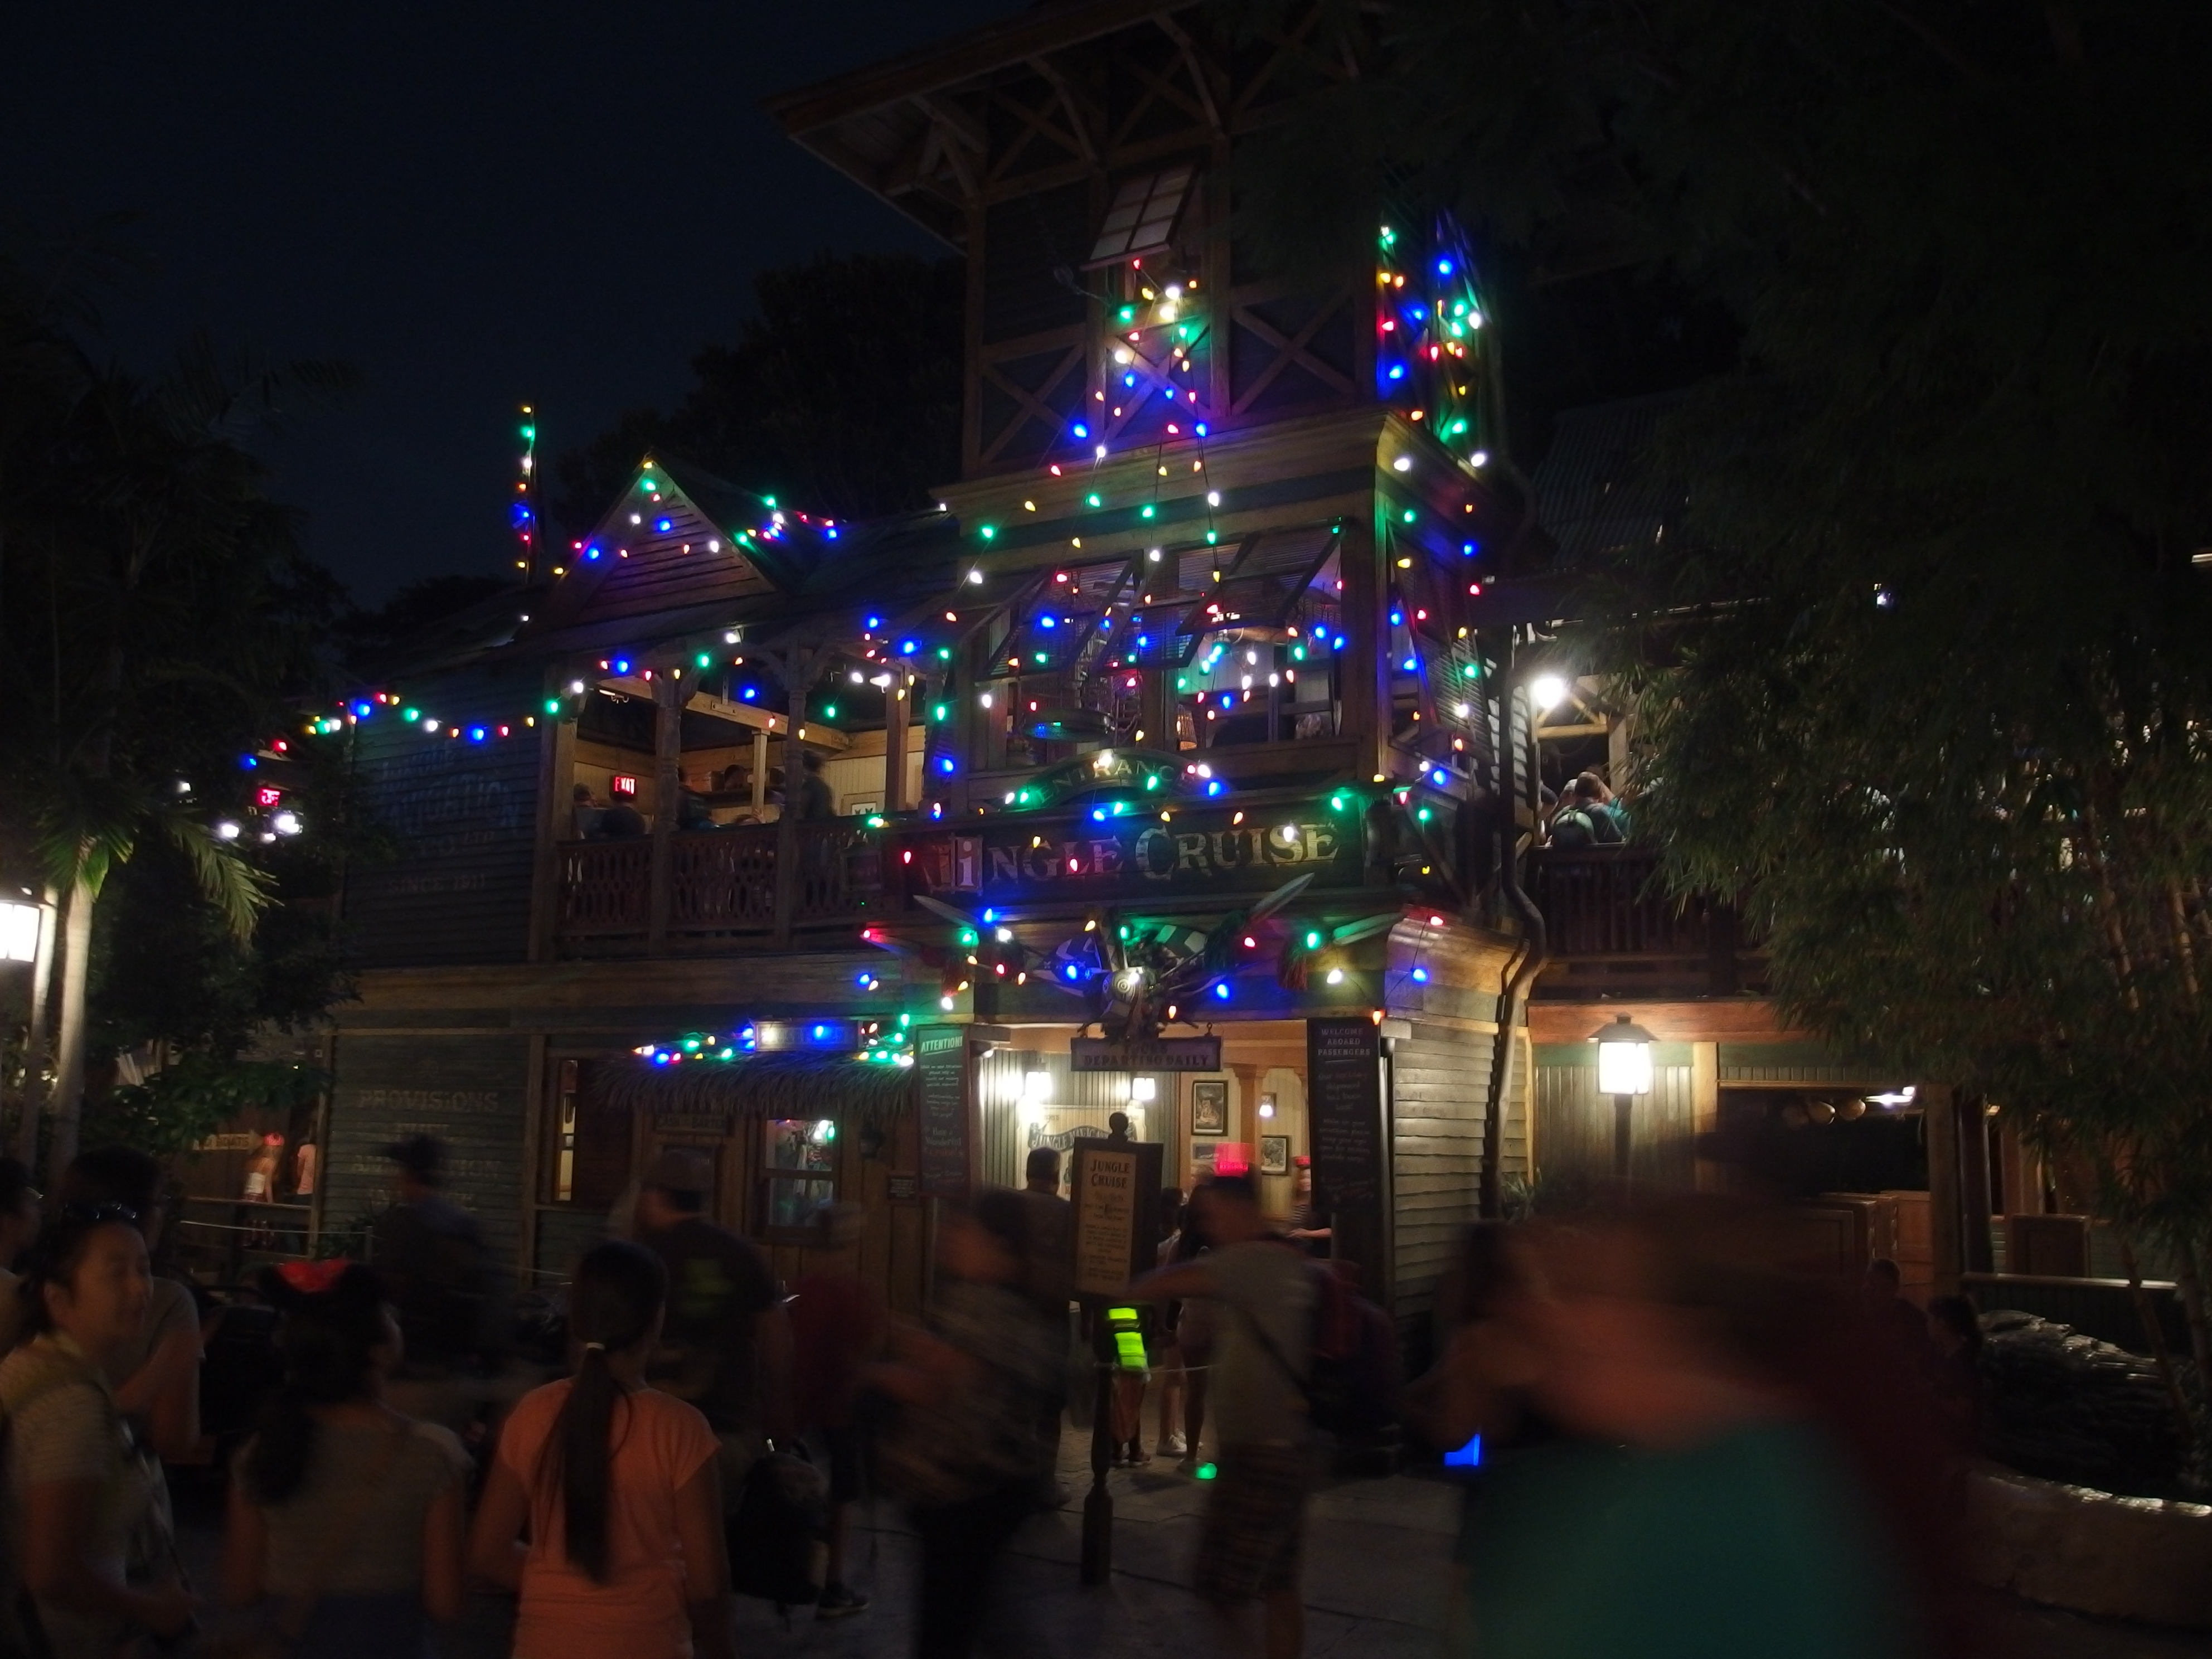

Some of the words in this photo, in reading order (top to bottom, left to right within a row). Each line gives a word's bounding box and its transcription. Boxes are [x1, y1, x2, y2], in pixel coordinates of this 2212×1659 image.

[615, 777, 635, 794] EXIT
[1136, 822, 1339, 880] CRUISE
[920, 1036, 963, 1053] ATTENTION!
[1084, 1055, 1163, 1066] DEPARTING
[1166, 1055, 1209, 1066] DAILY
[357, 1089, 499, 1113] PROVISIONS
[1090, 1159, 1131, 1174] JUNGLE
[1091, 1173, 1128, 1189] CRUISE
